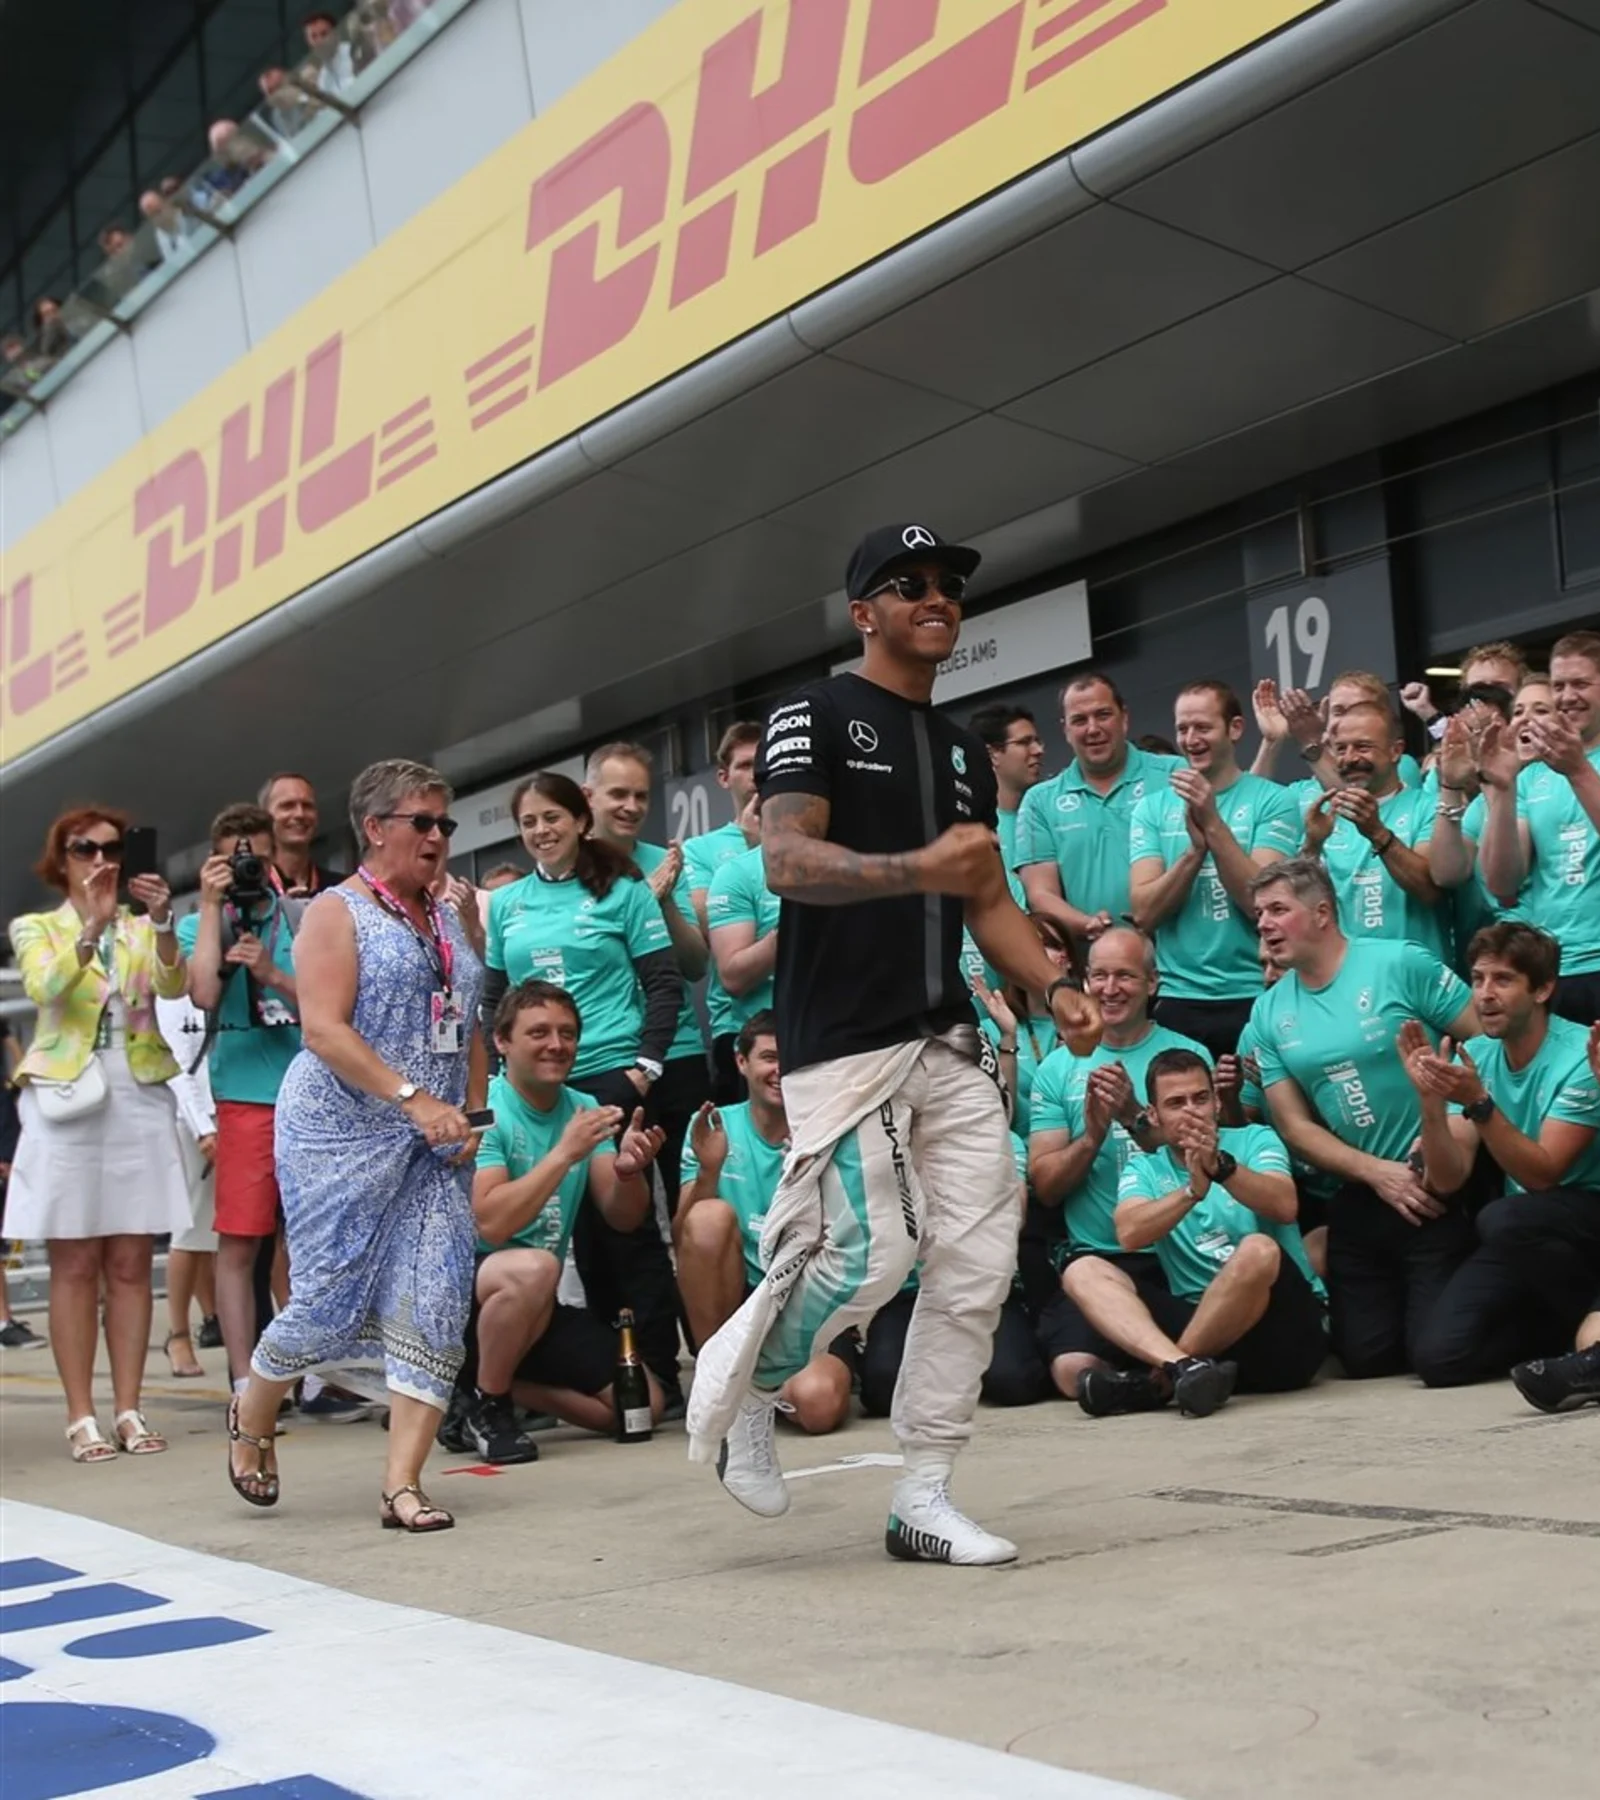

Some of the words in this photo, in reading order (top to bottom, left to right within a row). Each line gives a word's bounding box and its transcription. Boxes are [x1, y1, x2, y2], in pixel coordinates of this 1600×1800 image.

[525, 0, 1025, 393] DHL
[133, 330, 376, 639] DHL
[970, 638, 998, 667] AMG
[1264, 597, 1331, 694] 19
[671, 783, 710, 842] 20
[1209, 881, 1230, 923] 2015
[1364, 884, 1384, 929] 2015
[1342, 1080, 1376, 1129] 2015
